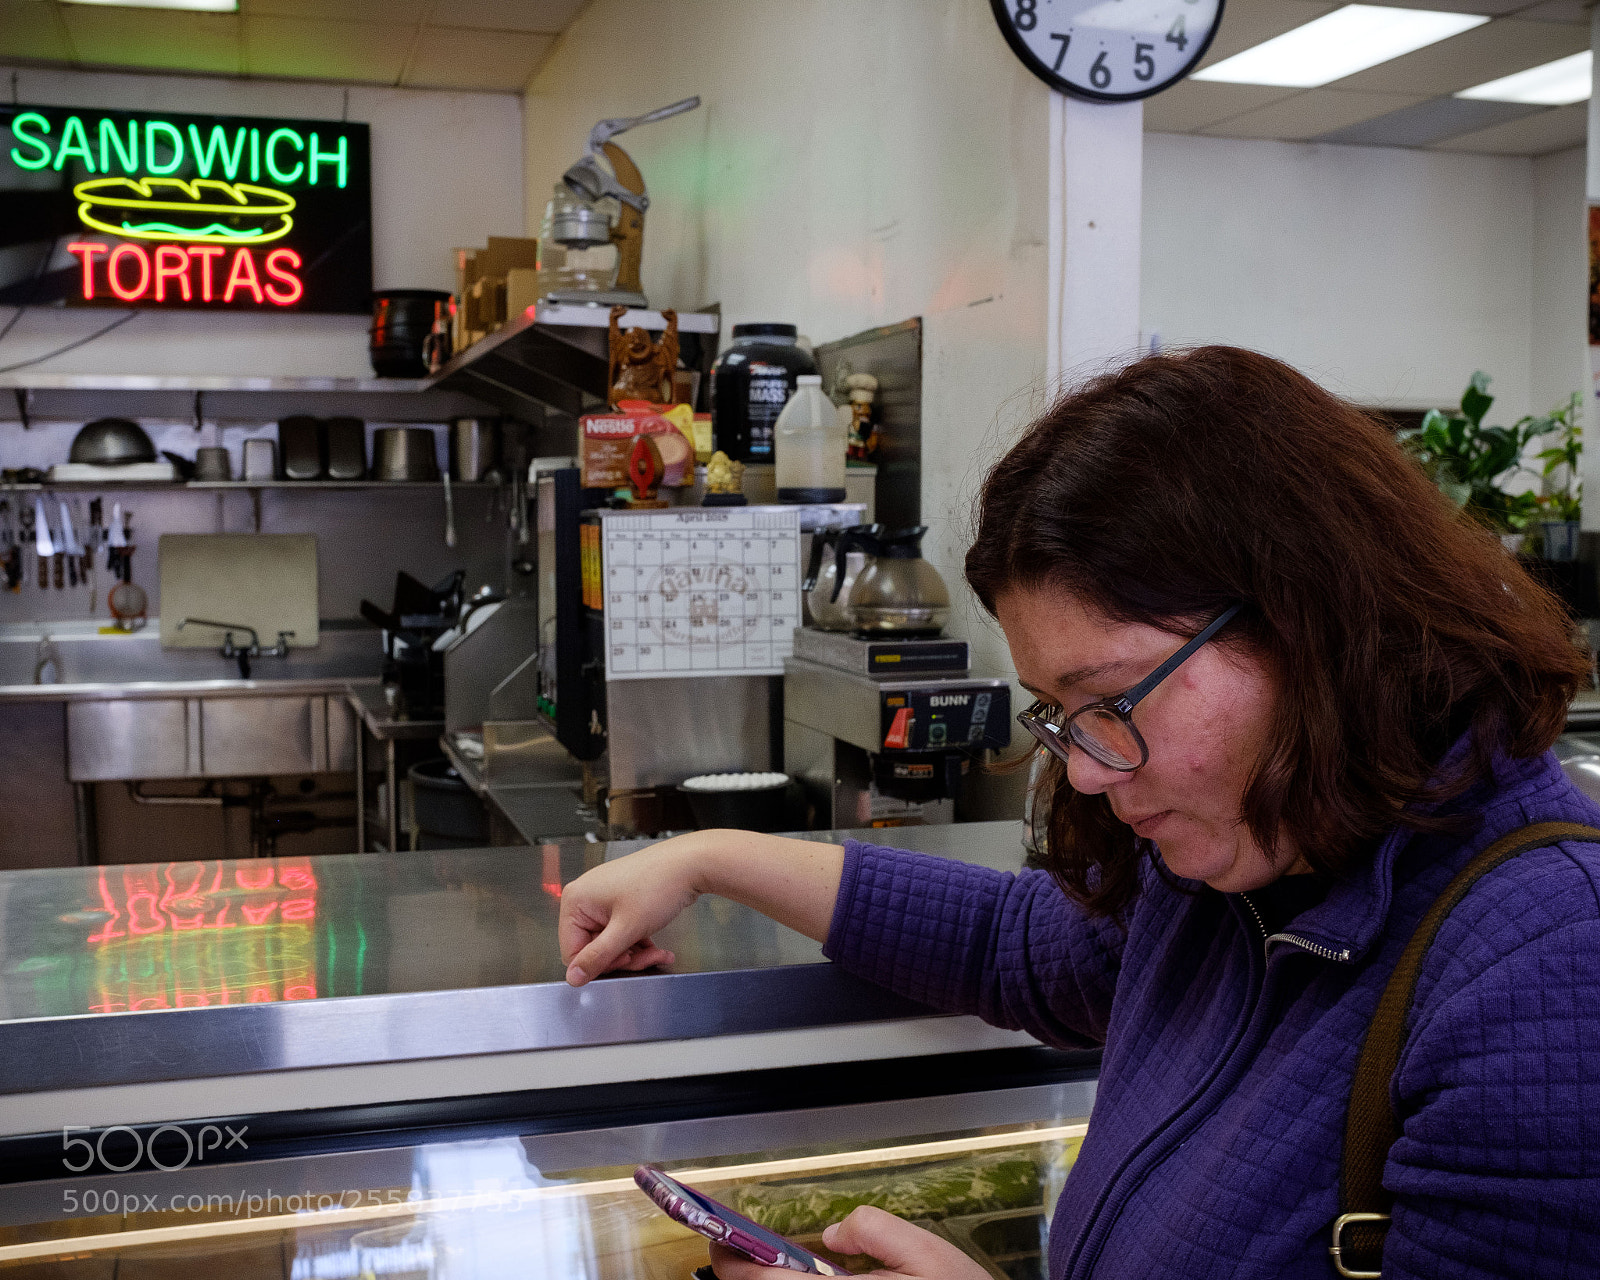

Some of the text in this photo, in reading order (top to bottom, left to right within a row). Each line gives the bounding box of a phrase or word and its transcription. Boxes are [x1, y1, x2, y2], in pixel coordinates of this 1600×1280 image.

[1015, 0, 1037, 32] 8
[1165, 14, 1189, 52] 4
[1050, 33, 1071, 72] 7
[1090, 51, 1112, 89] 6
[1134, 43, 1155, 81] 5
[10, 111, 348, 189] SANDWICH
[67, 242, 303, 305] TORTAS
[676, 512, 703, 524] April
[929, 695, 969, 707] BUNN
